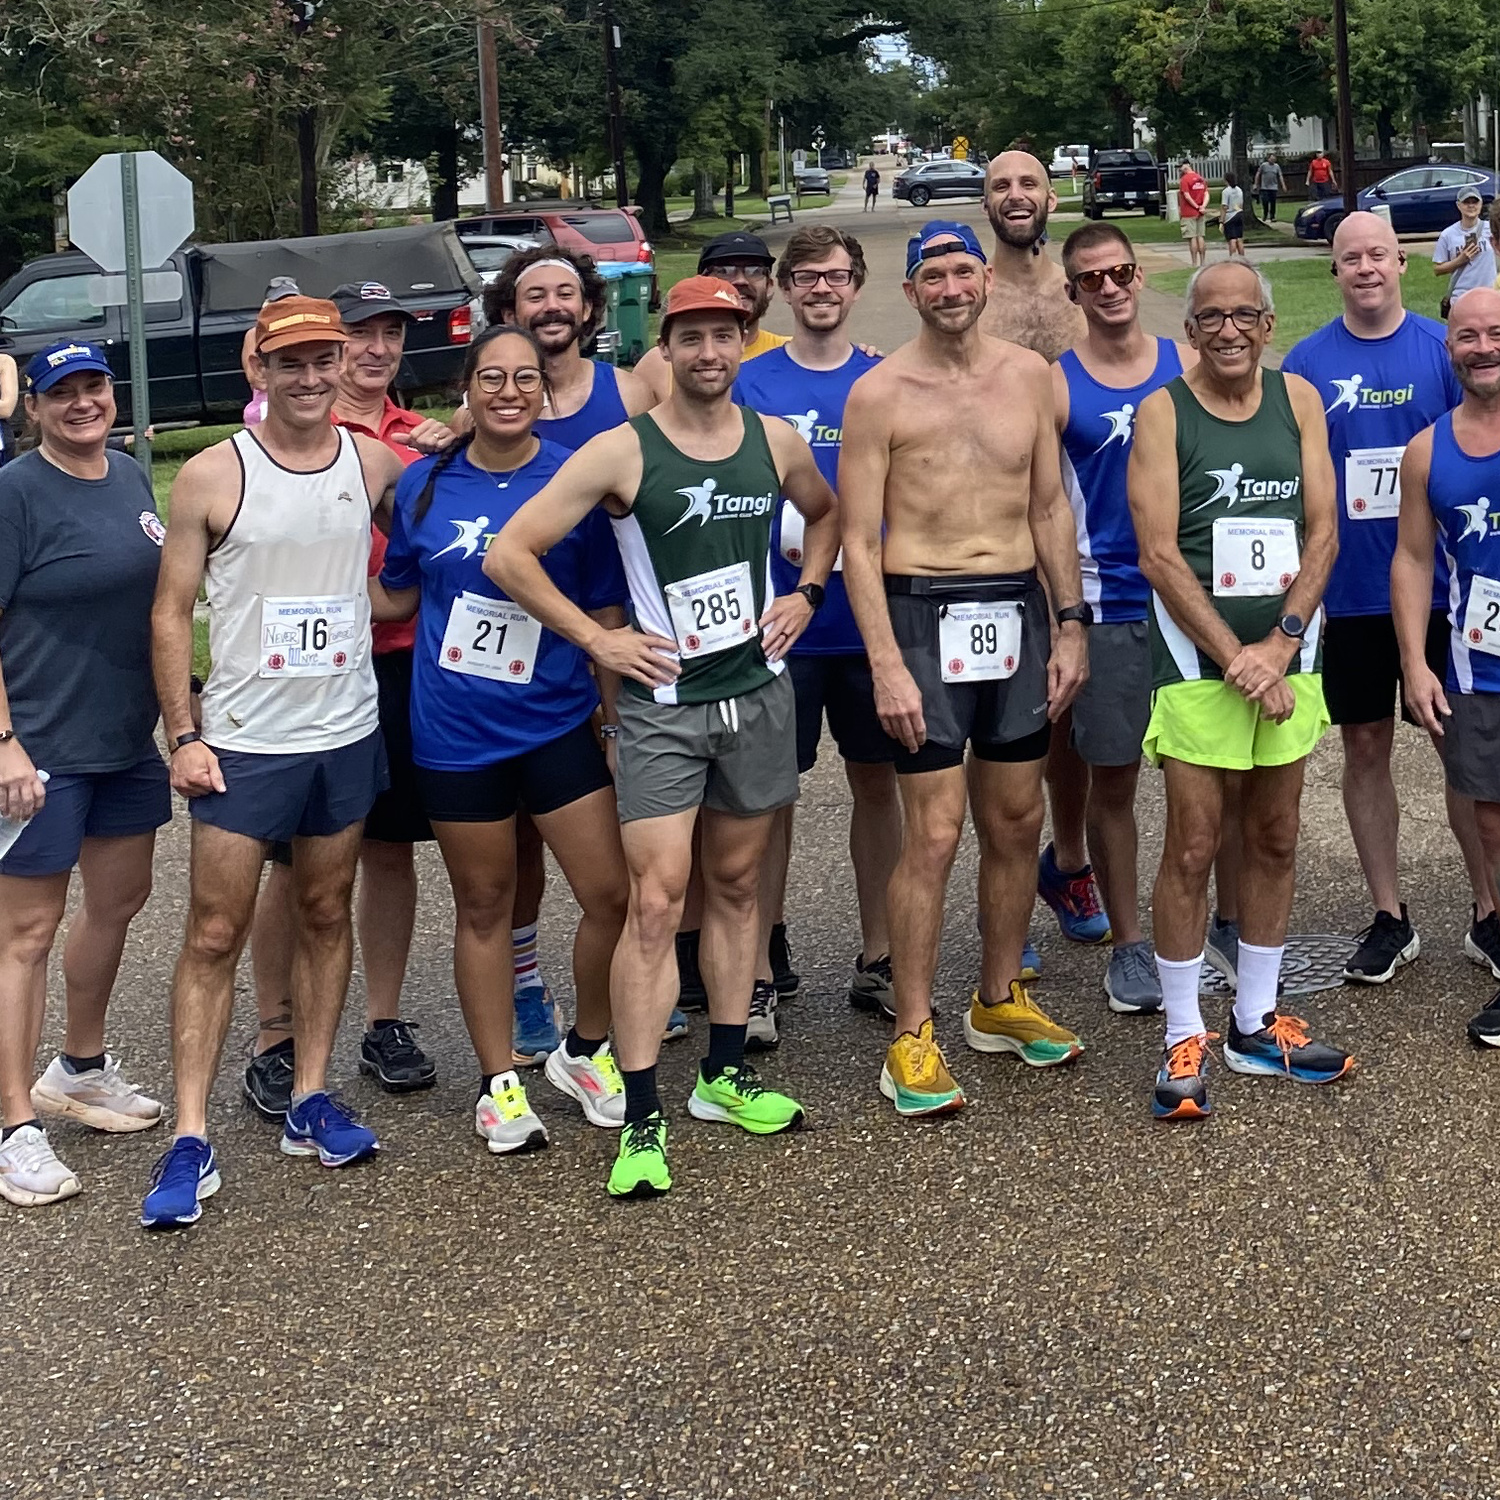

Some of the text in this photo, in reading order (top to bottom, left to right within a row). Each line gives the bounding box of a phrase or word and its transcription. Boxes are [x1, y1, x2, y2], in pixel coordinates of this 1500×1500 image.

[1359, 383, 1414, 405] Tangi
[1241, 475, 1300, 499] Tangi
[1370, 467, 1398, 496] 77
[713, 492, 773, 516] Tangi
[1227, 528, 1284, 536] MEMORIAL RUN
[1251, 539, 1266, 571] 8
[681, 576, 741, 597] MEMORIAL RUN
[278, 606, 342, 616] MEMORIAL RUN
[466, 604, 528, 622] MEMORIAL RUN
[691, 588, 741, 631] 285
[954, 611, 1010, 621] MEMORIAL RUN
[265, 625, 298, 644] NEVER
[296, 618, 328, 651] 16
[472, 619, 508, 655] 21
[970, 622, 998, 656] 89
